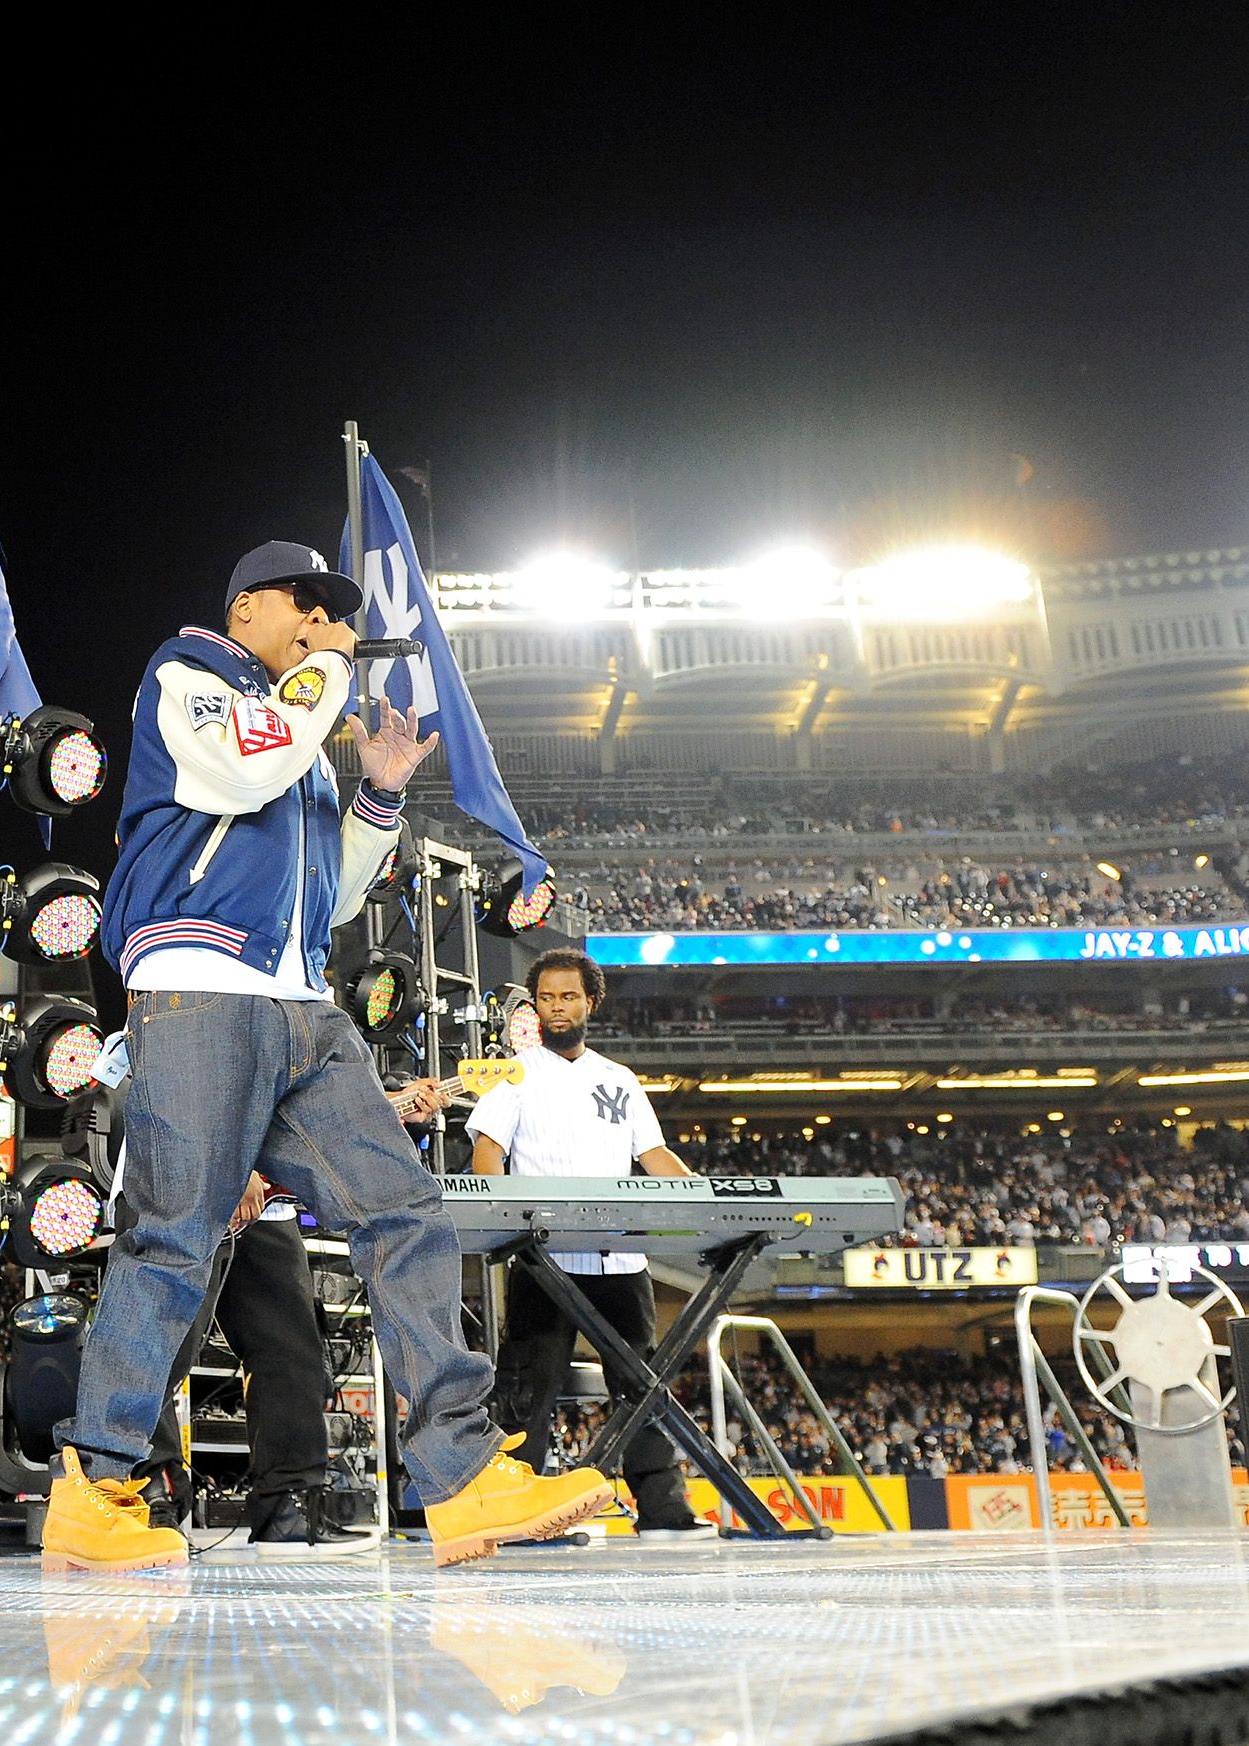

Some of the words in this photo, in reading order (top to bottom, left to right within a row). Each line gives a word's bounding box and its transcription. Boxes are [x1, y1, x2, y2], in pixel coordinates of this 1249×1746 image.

[1080, 931, 1155, 958] JAY-Z
[1162, 931, 1184, 957] &
[591, 1084, 630, 1124] NY
[435, 1178, 491, 1193] MAHA
[904, 1252, 974, 1282] UTZ
